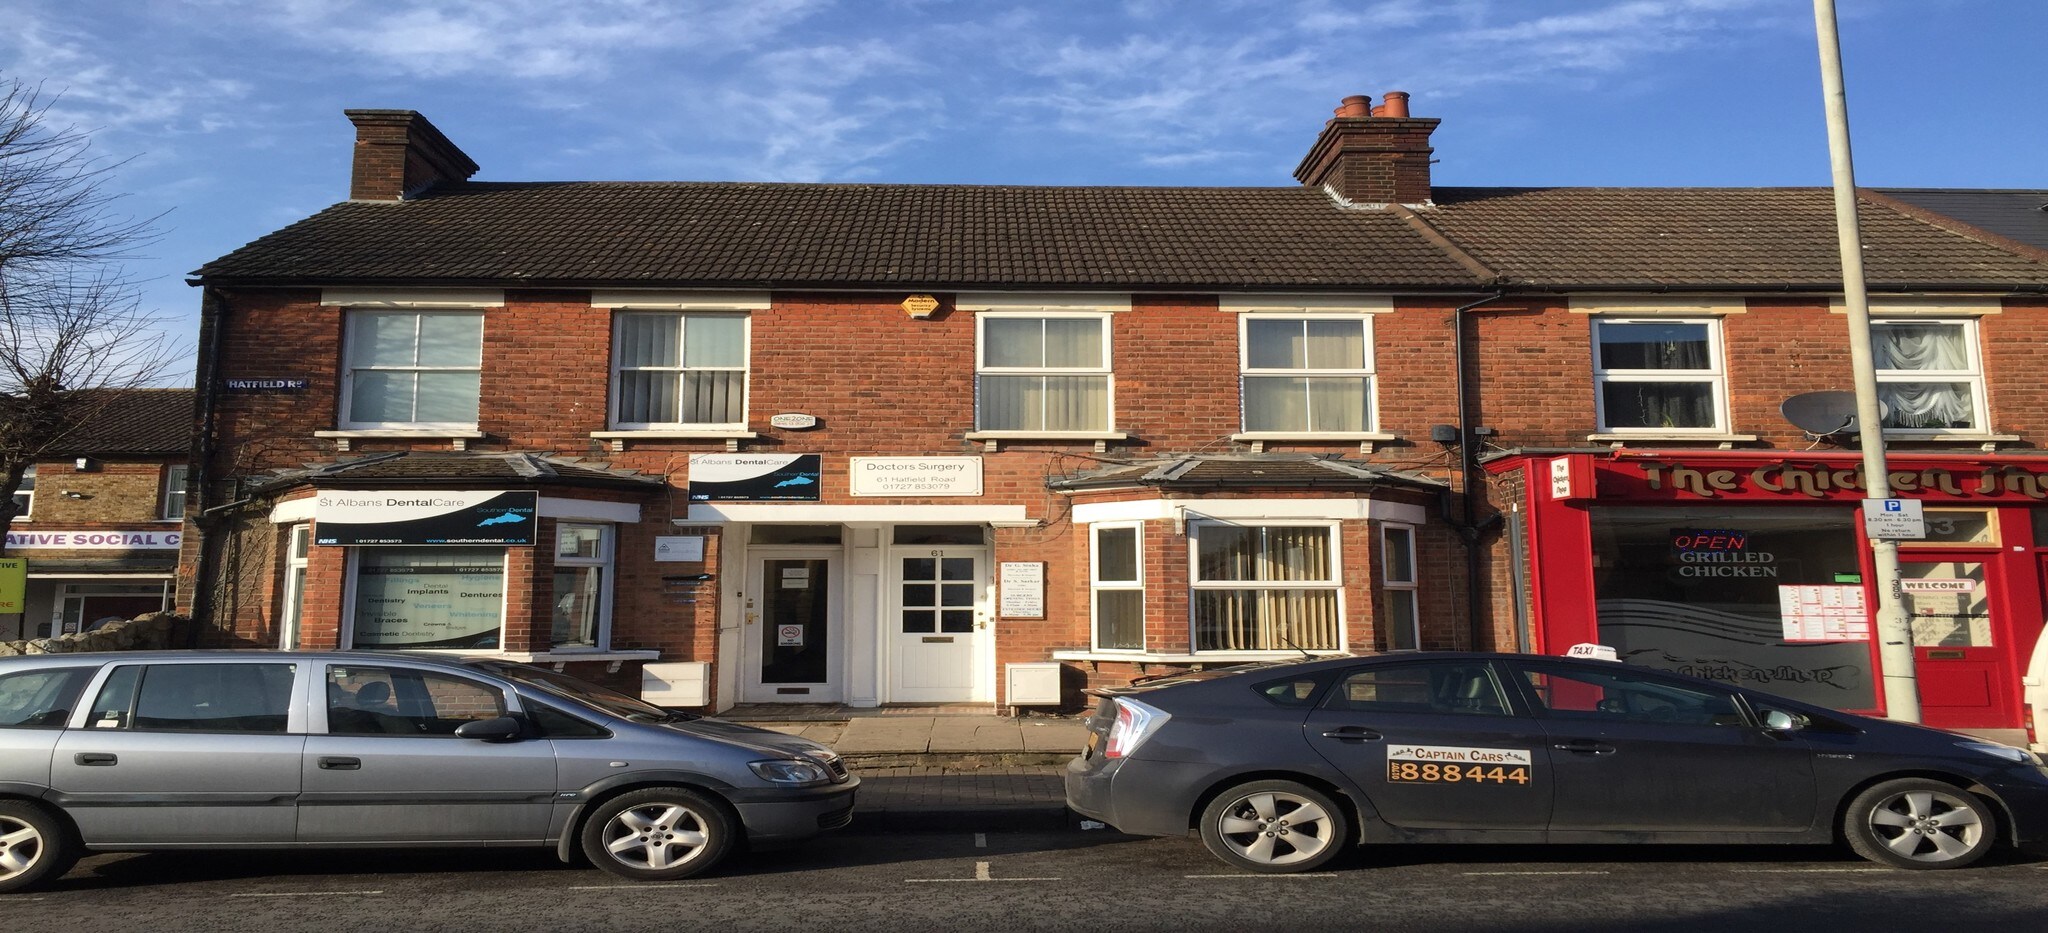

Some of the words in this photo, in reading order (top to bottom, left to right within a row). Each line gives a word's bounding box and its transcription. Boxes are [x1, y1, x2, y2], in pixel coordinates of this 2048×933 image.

[866, 462, 916, 470] Doctors
[918, 462, 965, 472] Surgery
[1638, 462, 1737, 496] The
[319, 498, 332, 506] St
[336, 498, 382, 506] Albans
[386, 498, 464, 506] DentalCare
[1888, 502, 1899, 510] P
[72, 534, 158, 545] SOCIAL
[1675, 536, 1745, 550] OPEN
[1680, 552, 1775, 563] GRILLED
[1679, 566, 1778, 578] CHICKEN
[1574, 647, 1594, 655] TAXI
[1415, 748, 1466, 761] CAPTAIN
[1470, 750, 1504, 762] CARS
[1400, 762, 1529, 784] 888444
